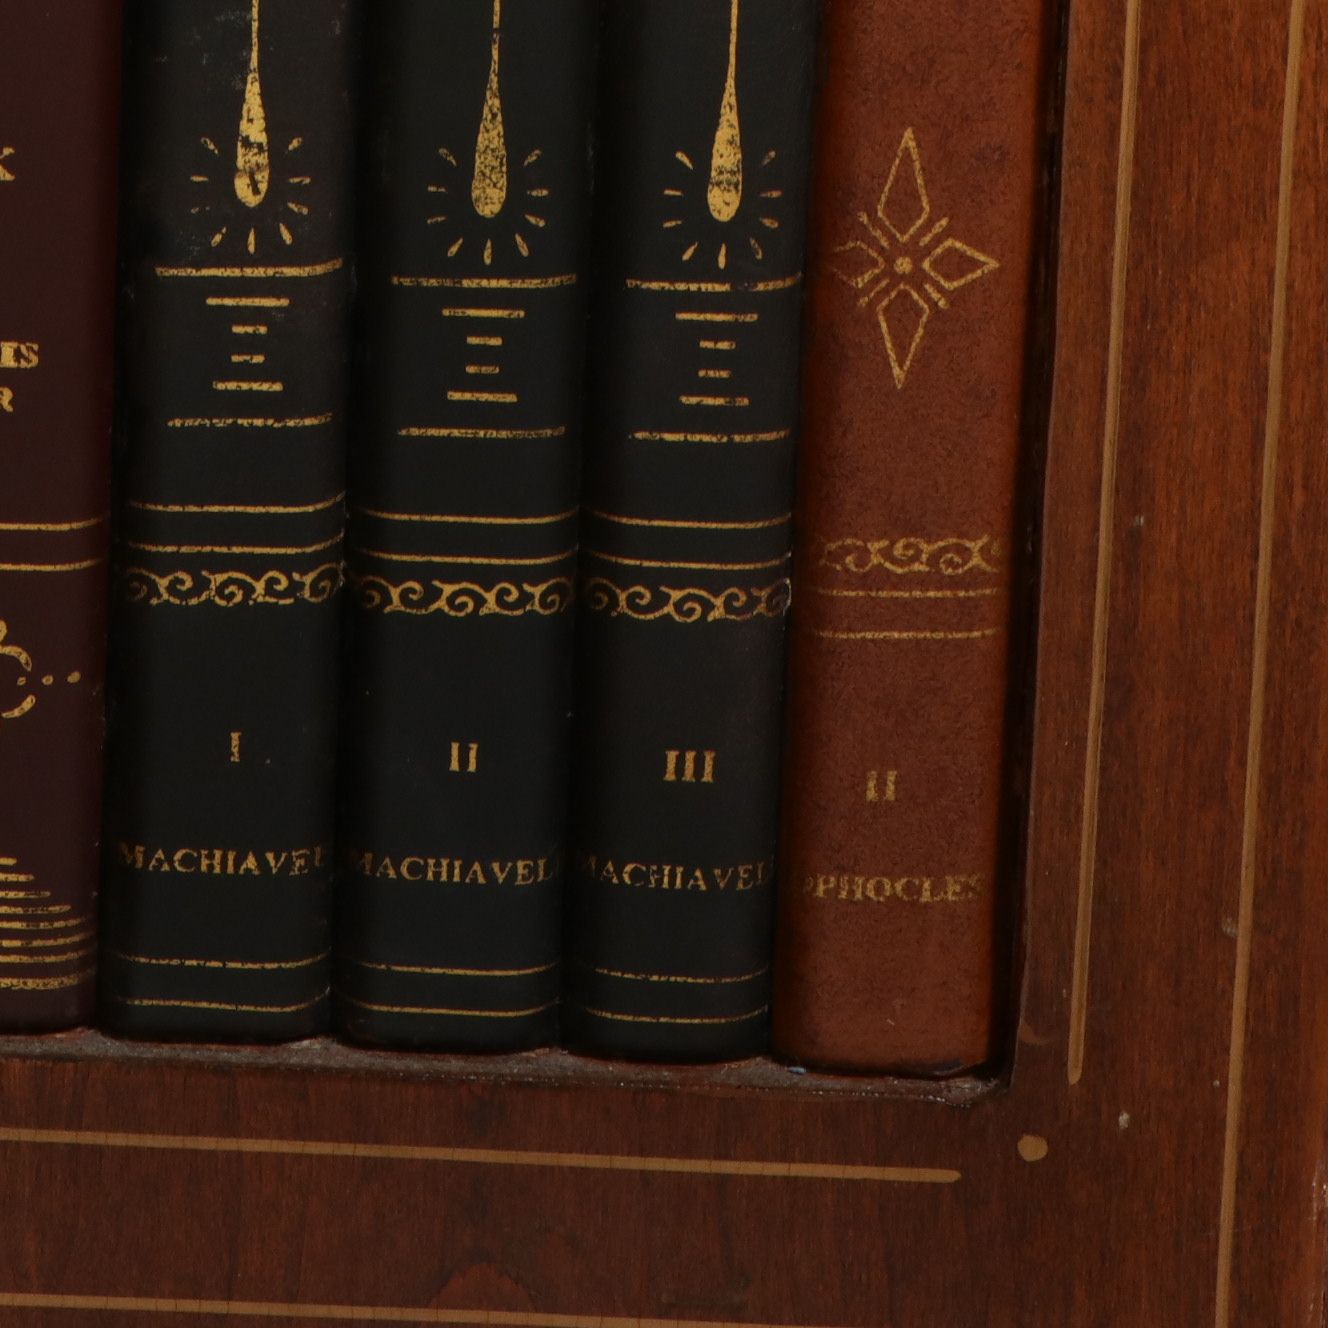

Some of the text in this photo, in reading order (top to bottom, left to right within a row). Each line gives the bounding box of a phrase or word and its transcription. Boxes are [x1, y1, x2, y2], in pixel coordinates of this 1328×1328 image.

[230, 731, 242, 762] I
[449, 741, 479, 773] II
[664, 749, 715, 783] III
[866, 770, 898, 802] II
[586, 855, 769, 892] ACHIAVEL
